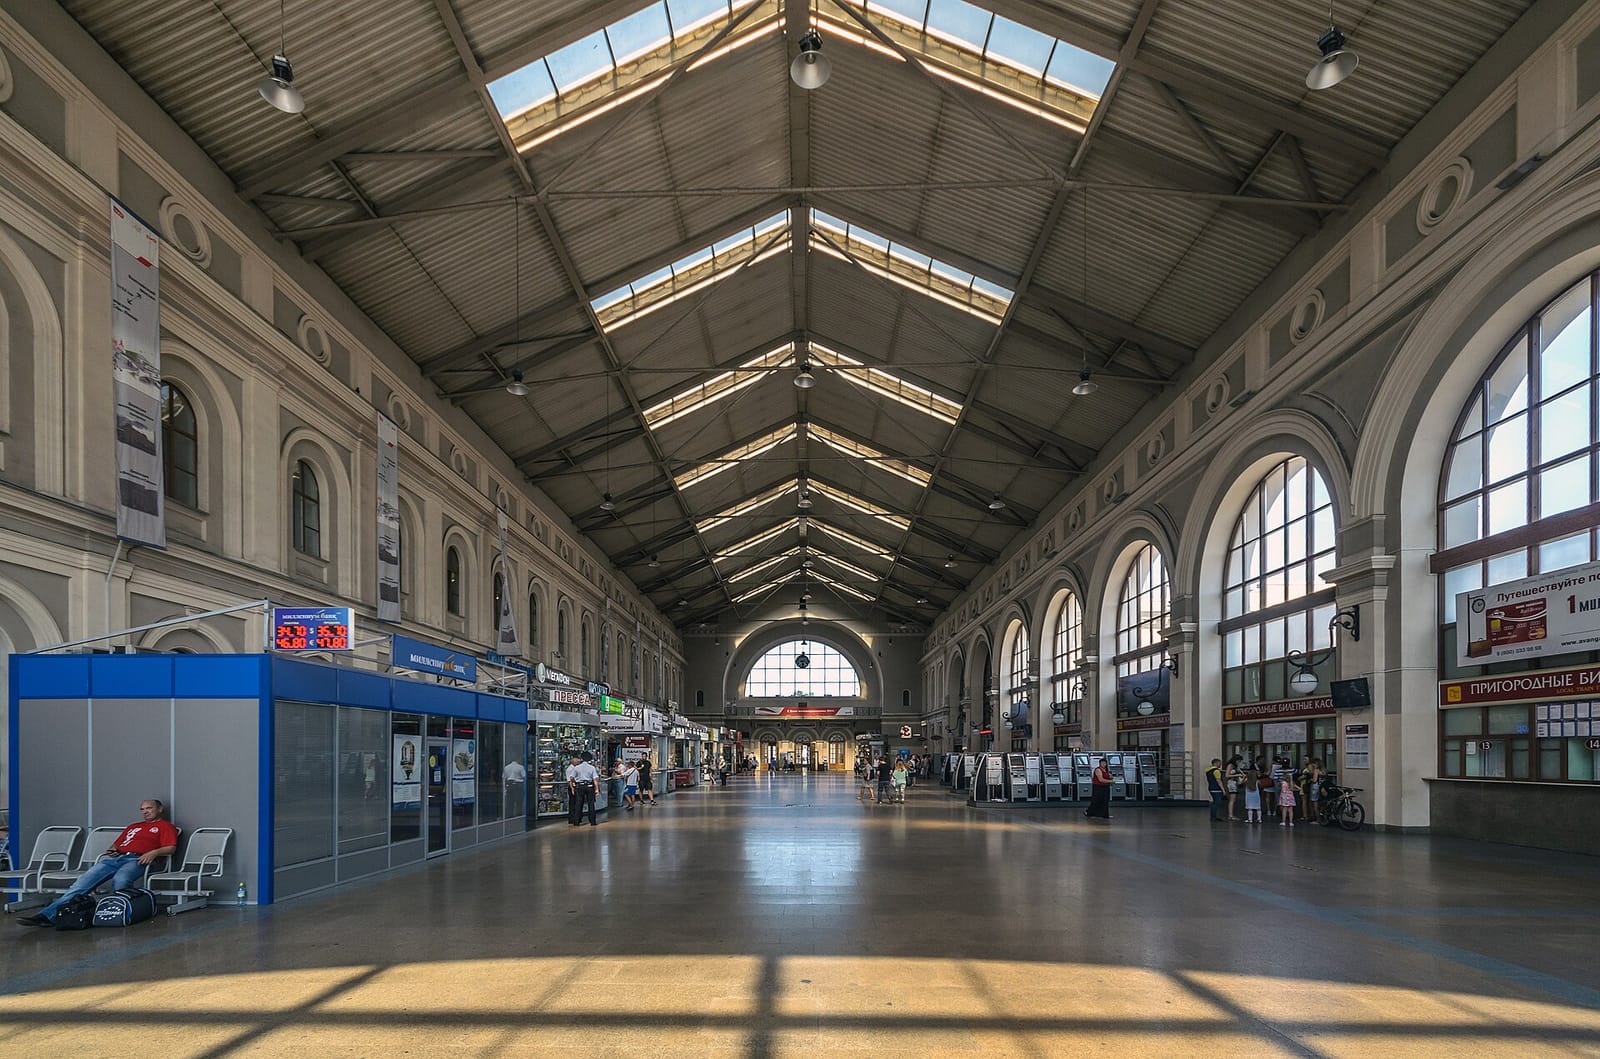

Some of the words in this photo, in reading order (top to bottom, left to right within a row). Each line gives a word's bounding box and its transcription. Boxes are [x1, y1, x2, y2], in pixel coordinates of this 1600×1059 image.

[1497, 576, 1585, 602] Путешествуйте
[1567, 594, 1576, 614] 1
[1561, 636, 1600, 647] www.avang
[1471, 674, 1574, 695] ПРИГОРОДНЫЕ
[1556, 686, 1575, 694] LOCAL
[555, 691, 591, 706] ПРЕССА
[1235, 703, 1278, 716] ПРИГОРОДНЫЕ
[1278, 700, 1314, 712] БИЛЕТНЫЕ
[1481, 741, 1490, 750] 13
[1590, 740, 1600, 749] 14
